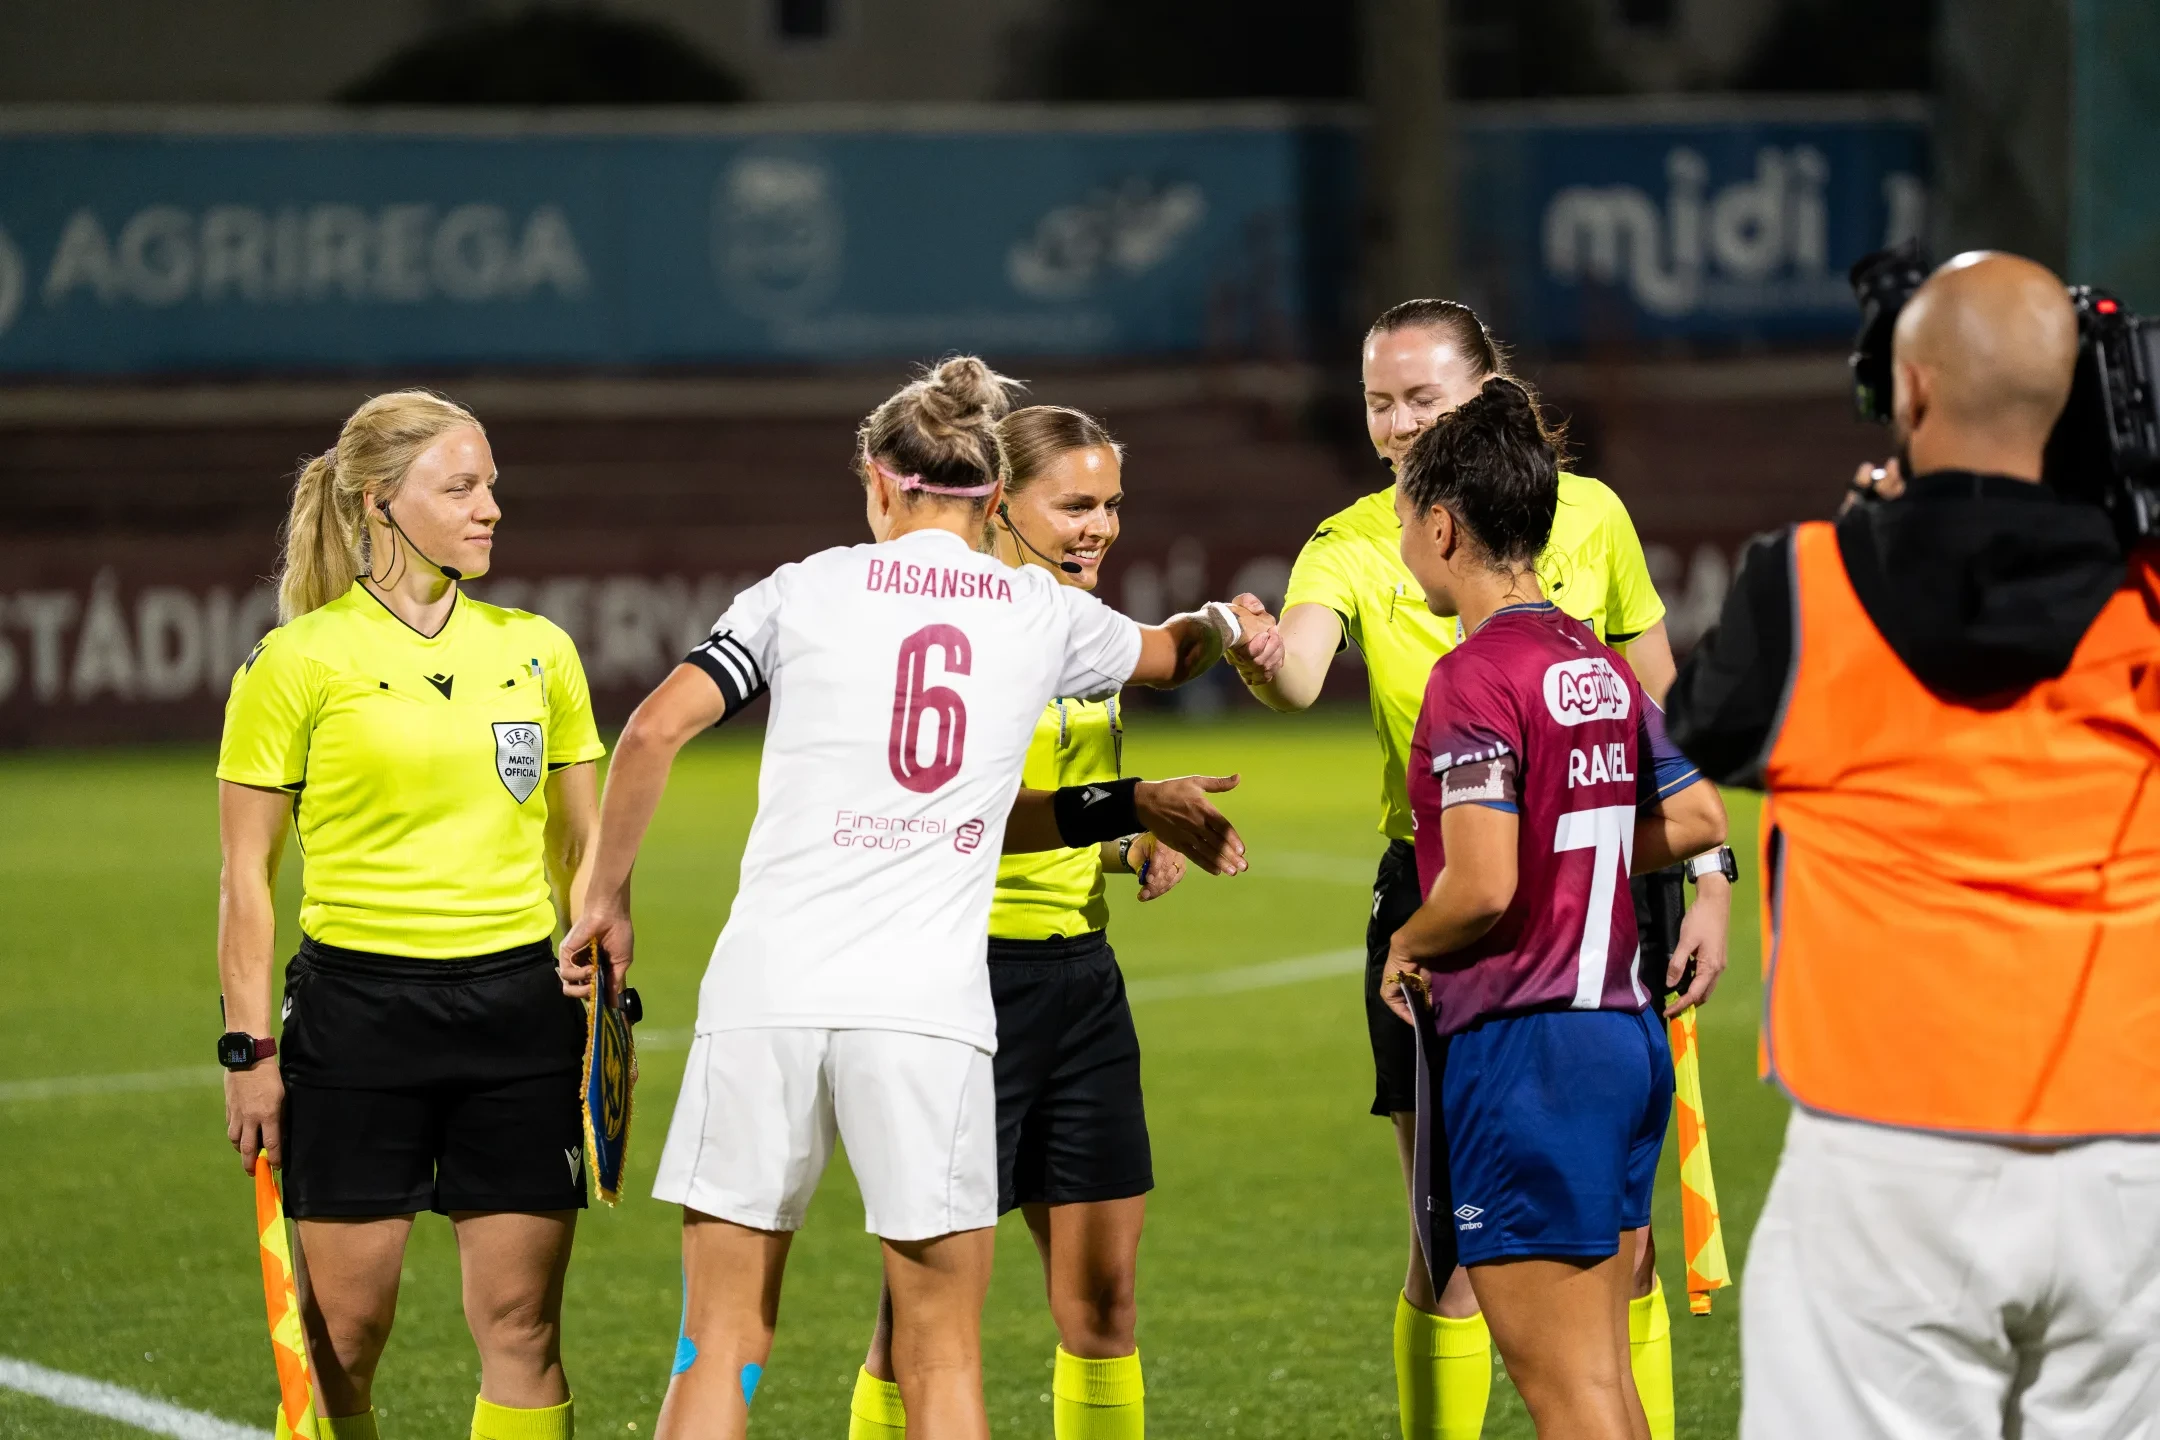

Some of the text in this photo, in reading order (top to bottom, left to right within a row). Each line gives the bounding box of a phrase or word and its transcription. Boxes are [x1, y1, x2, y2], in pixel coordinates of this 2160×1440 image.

[1542, 145, 1830, 316] midi
[43, 203, 588, 306] AGRIREGA
[866, 559, 1012, 603] BASANSKA
[888, 623, 972, 793] 6
[506, 731, 535, 746] UEFA
[504, 767, 537, 777] OFFICIAL
[508, 756, 535, 765] MATCH
[1568, 743, 1635, 789] RAVEL
[835, 810, 947, 834] Financial
[833, 829, 911, 852] Group
[1459, 1222, 1484, 1231] umbro
